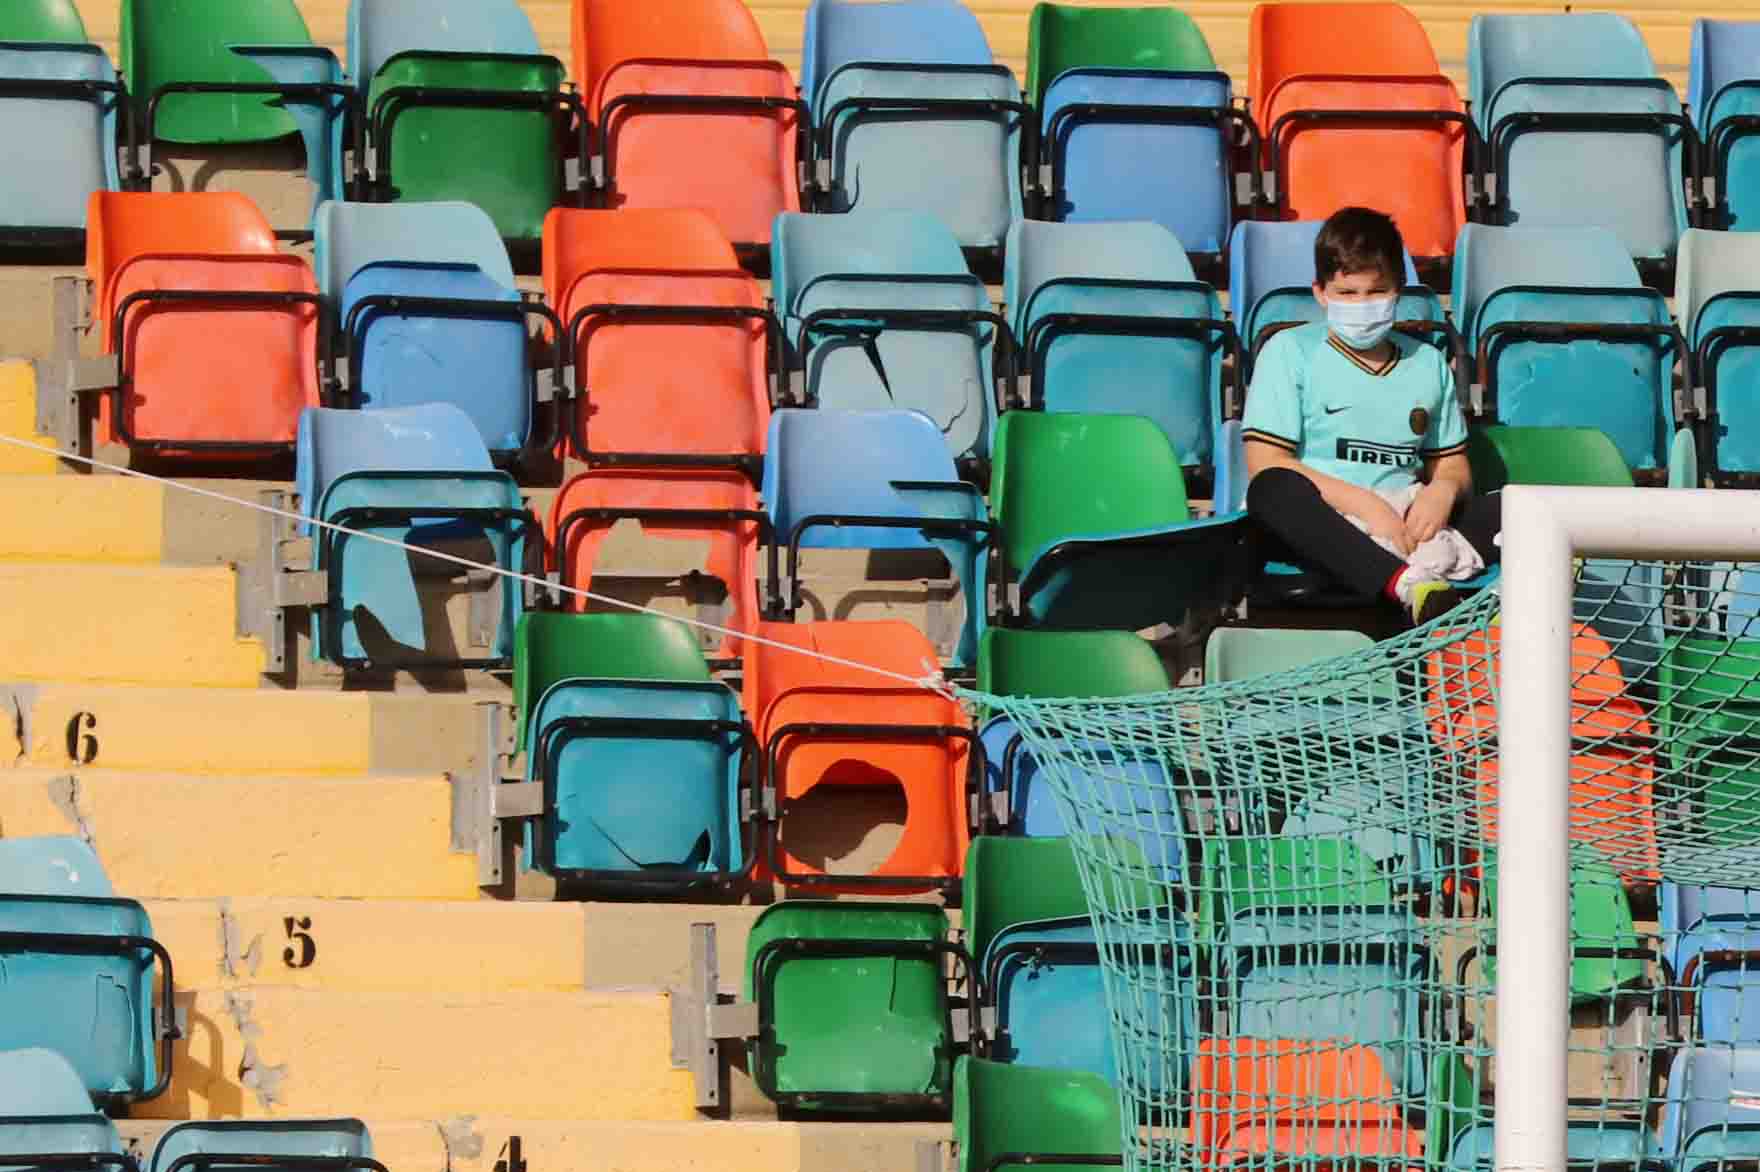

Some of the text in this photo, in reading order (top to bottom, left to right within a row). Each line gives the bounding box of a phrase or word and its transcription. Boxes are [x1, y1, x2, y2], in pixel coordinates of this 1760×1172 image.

[1336, 438, 1423, 468] PIRELL
[66, 711, 98, 764] 6
[283, 916, 316, 968] 5
